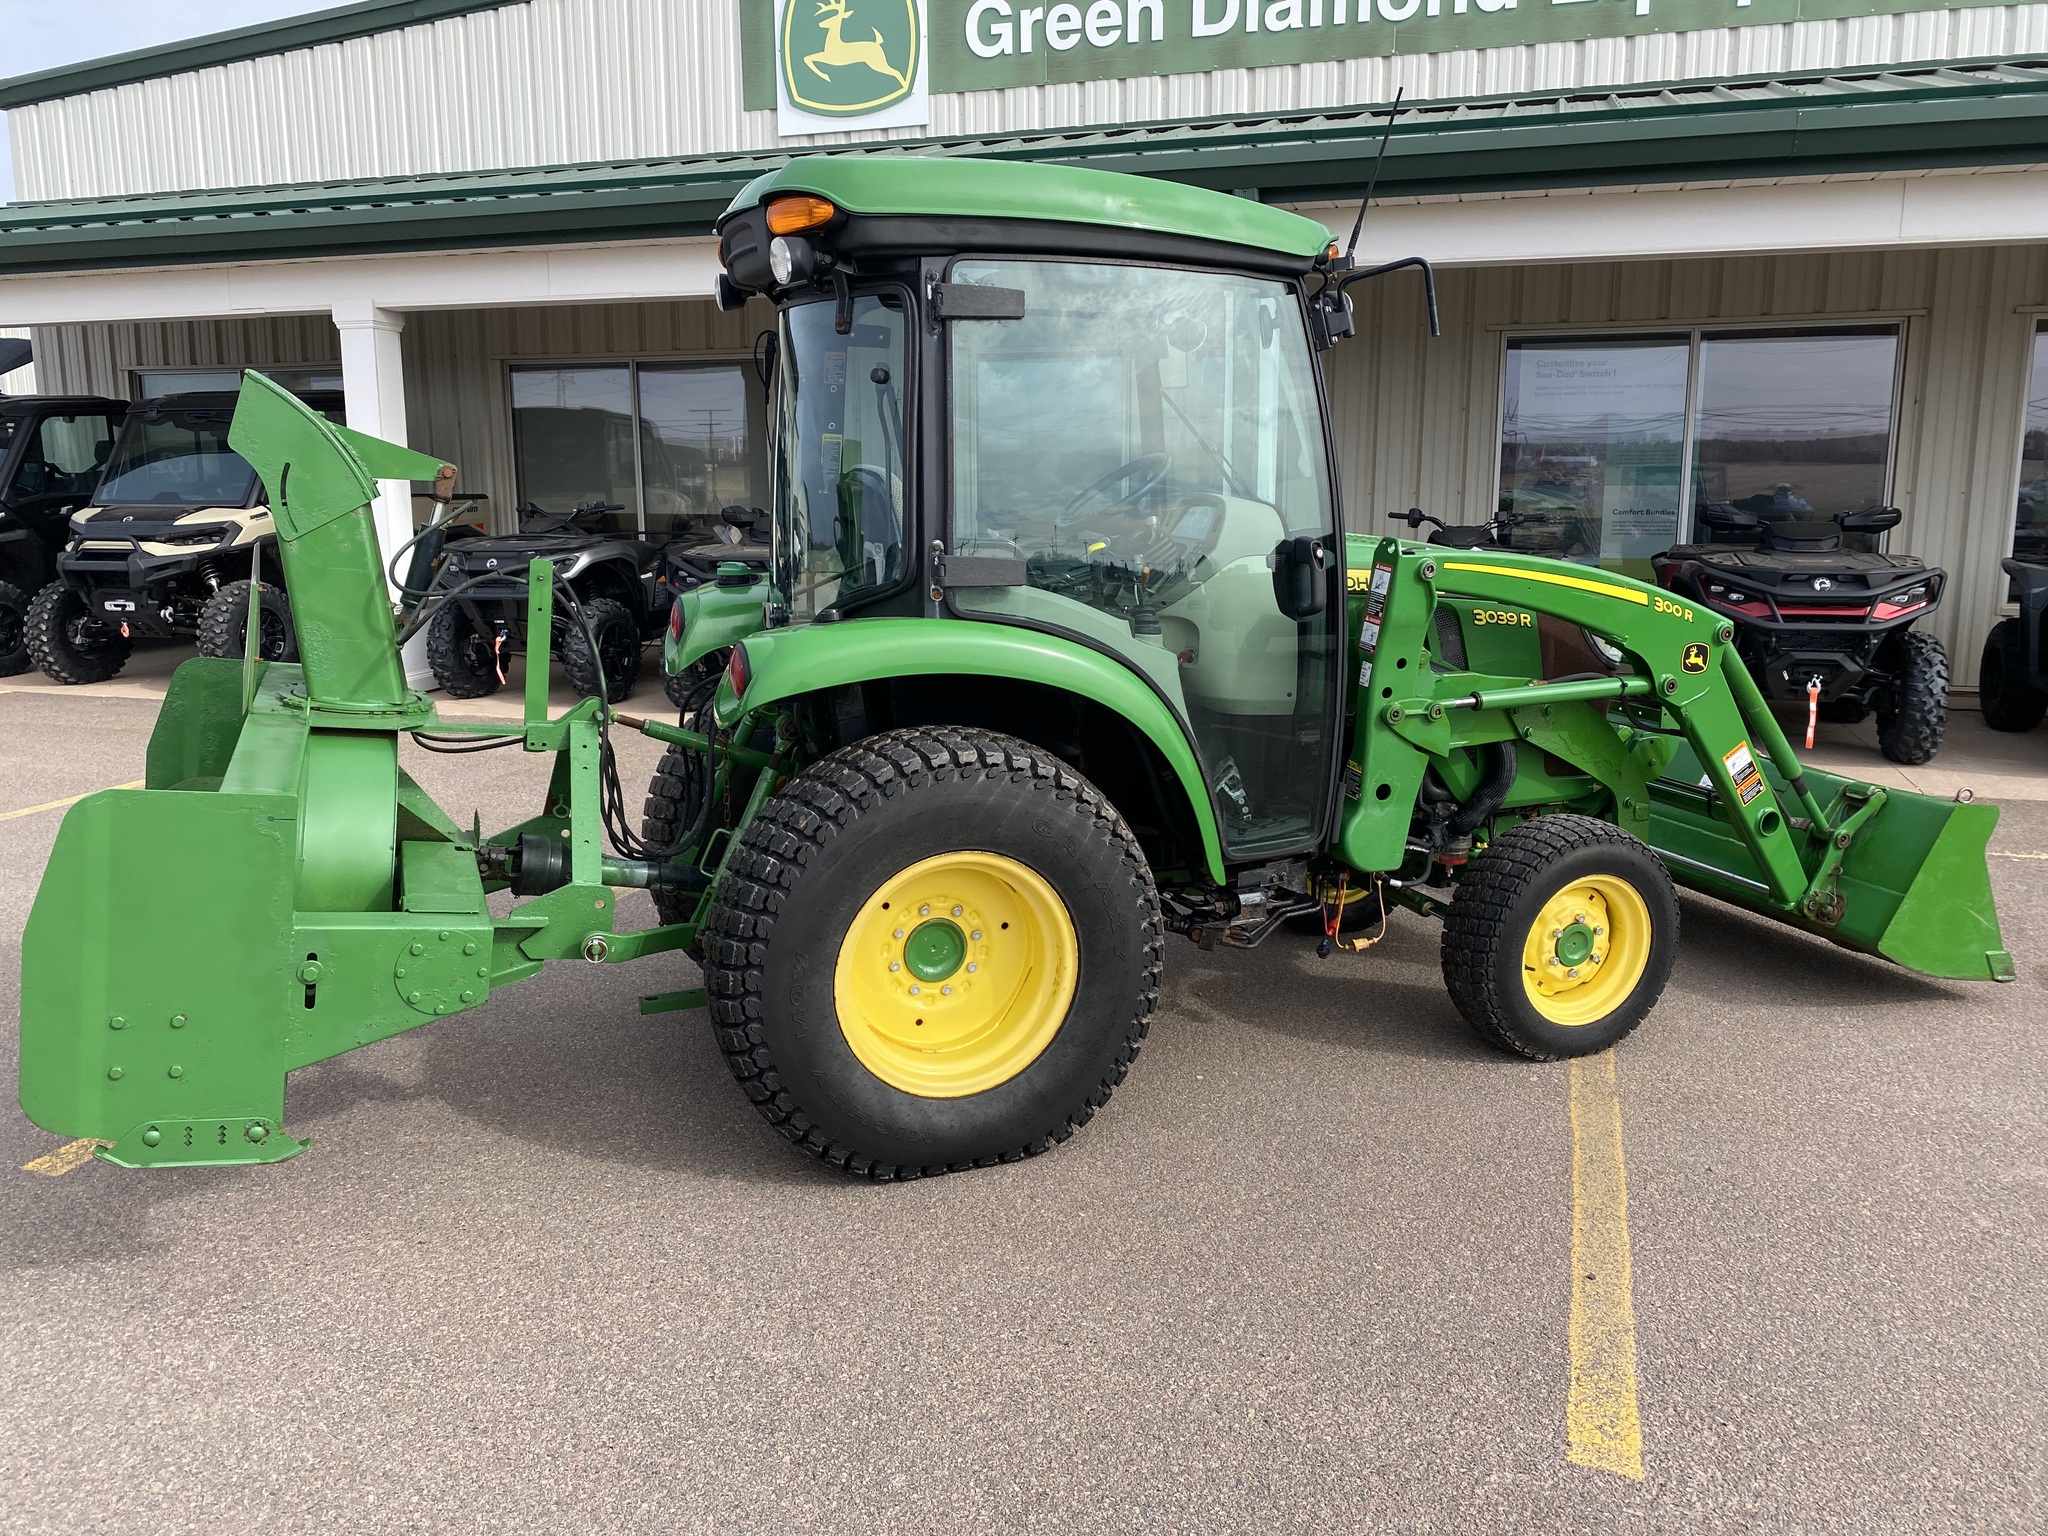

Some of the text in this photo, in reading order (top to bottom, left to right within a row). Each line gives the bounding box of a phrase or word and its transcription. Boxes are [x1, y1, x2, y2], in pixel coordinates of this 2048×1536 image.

[964, 0, 1518, 58] Green Diam
[1536, 359, 1609, 369] Customize your
[1612, 508, 1675, 516] Comfort Bundles
[1347, 576, 1368, 591] OH
[1653, 596, 1694, 623] 300 R
[1472, 609, 1532, 628] 3039 R
